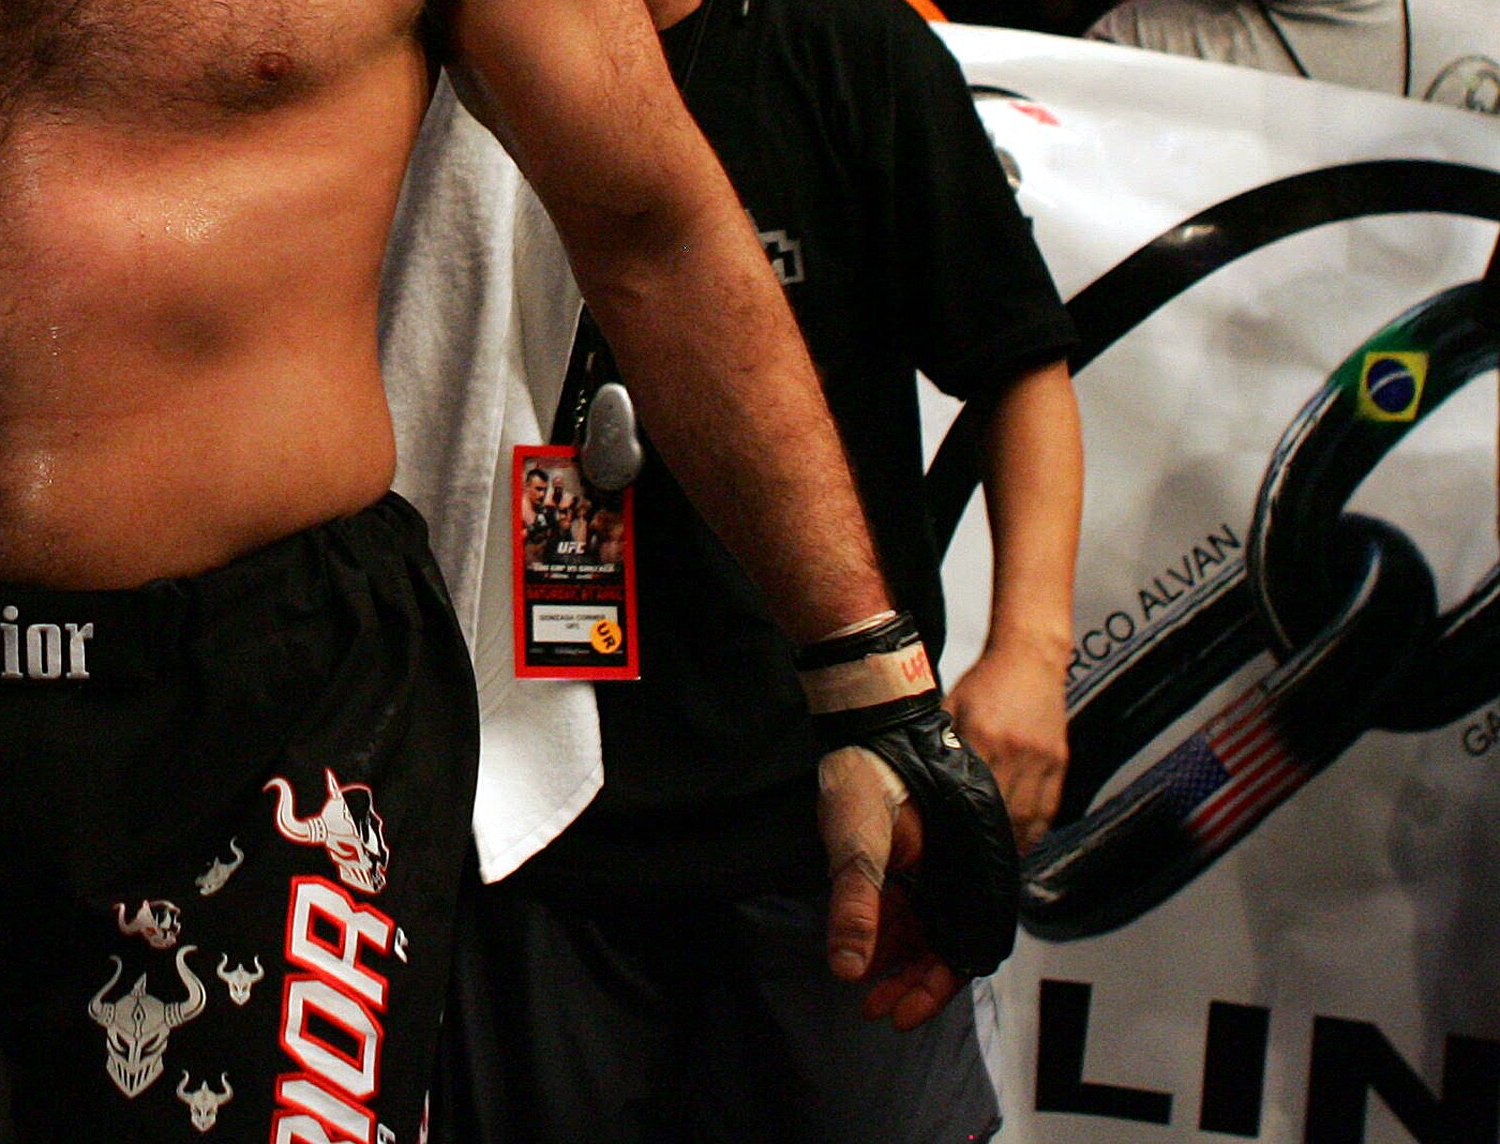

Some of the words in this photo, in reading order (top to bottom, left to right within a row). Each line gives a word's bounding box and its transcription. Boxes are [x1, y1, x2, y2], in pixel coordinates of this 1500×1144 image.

[557, 541, 586, 554] UFC
[1139, 523, 1241, 621] ALVAN
[597, 622, 615, 649] UR
[1035, 978, 1500, 1144] LIN
